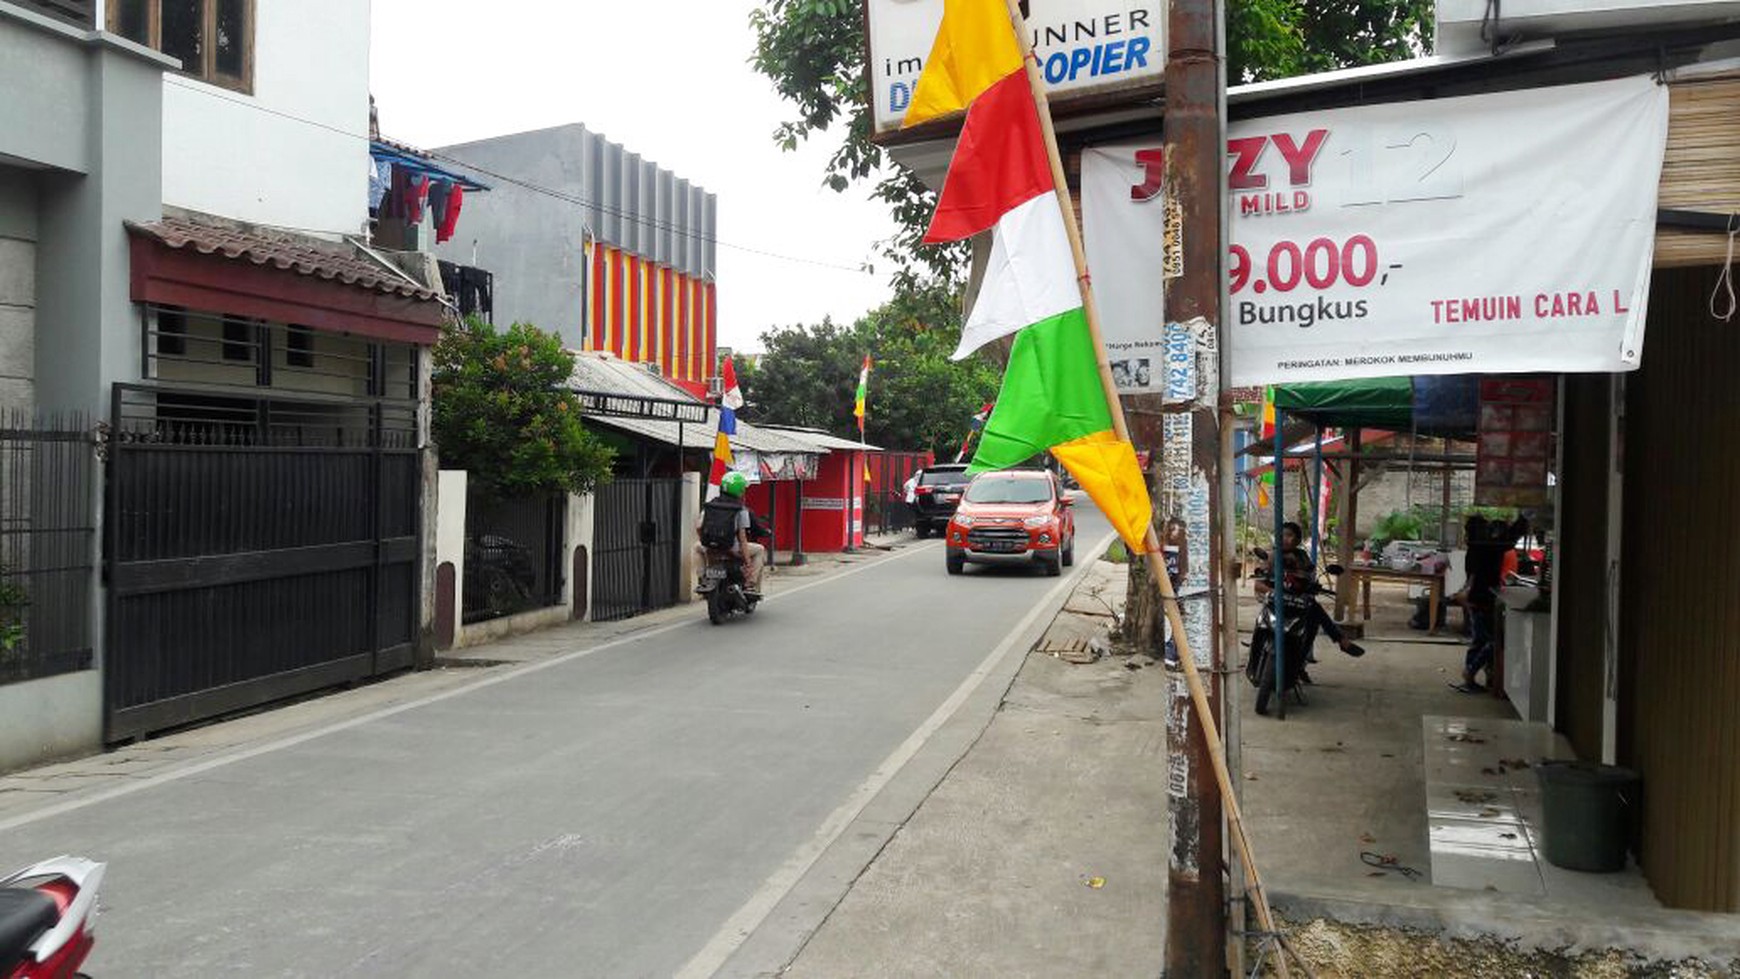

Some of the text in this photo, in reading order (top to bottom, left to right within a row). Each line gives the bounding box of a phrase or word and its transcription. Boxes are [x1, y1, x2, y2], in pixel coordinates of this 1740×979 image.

[890, 36, 1150, 113] D OPIER
[1240, 191, 1310, 217] MILD
[1239, 296, 1368, 328] Bungkus
[1431, 295, 1521, 324] TEMUIN
[1534, 291, 1600, 318] CARA
[1276, 358, 1343, 370] PERINGATAN:
[1345, 355, 1396, 367] MEROKOK
